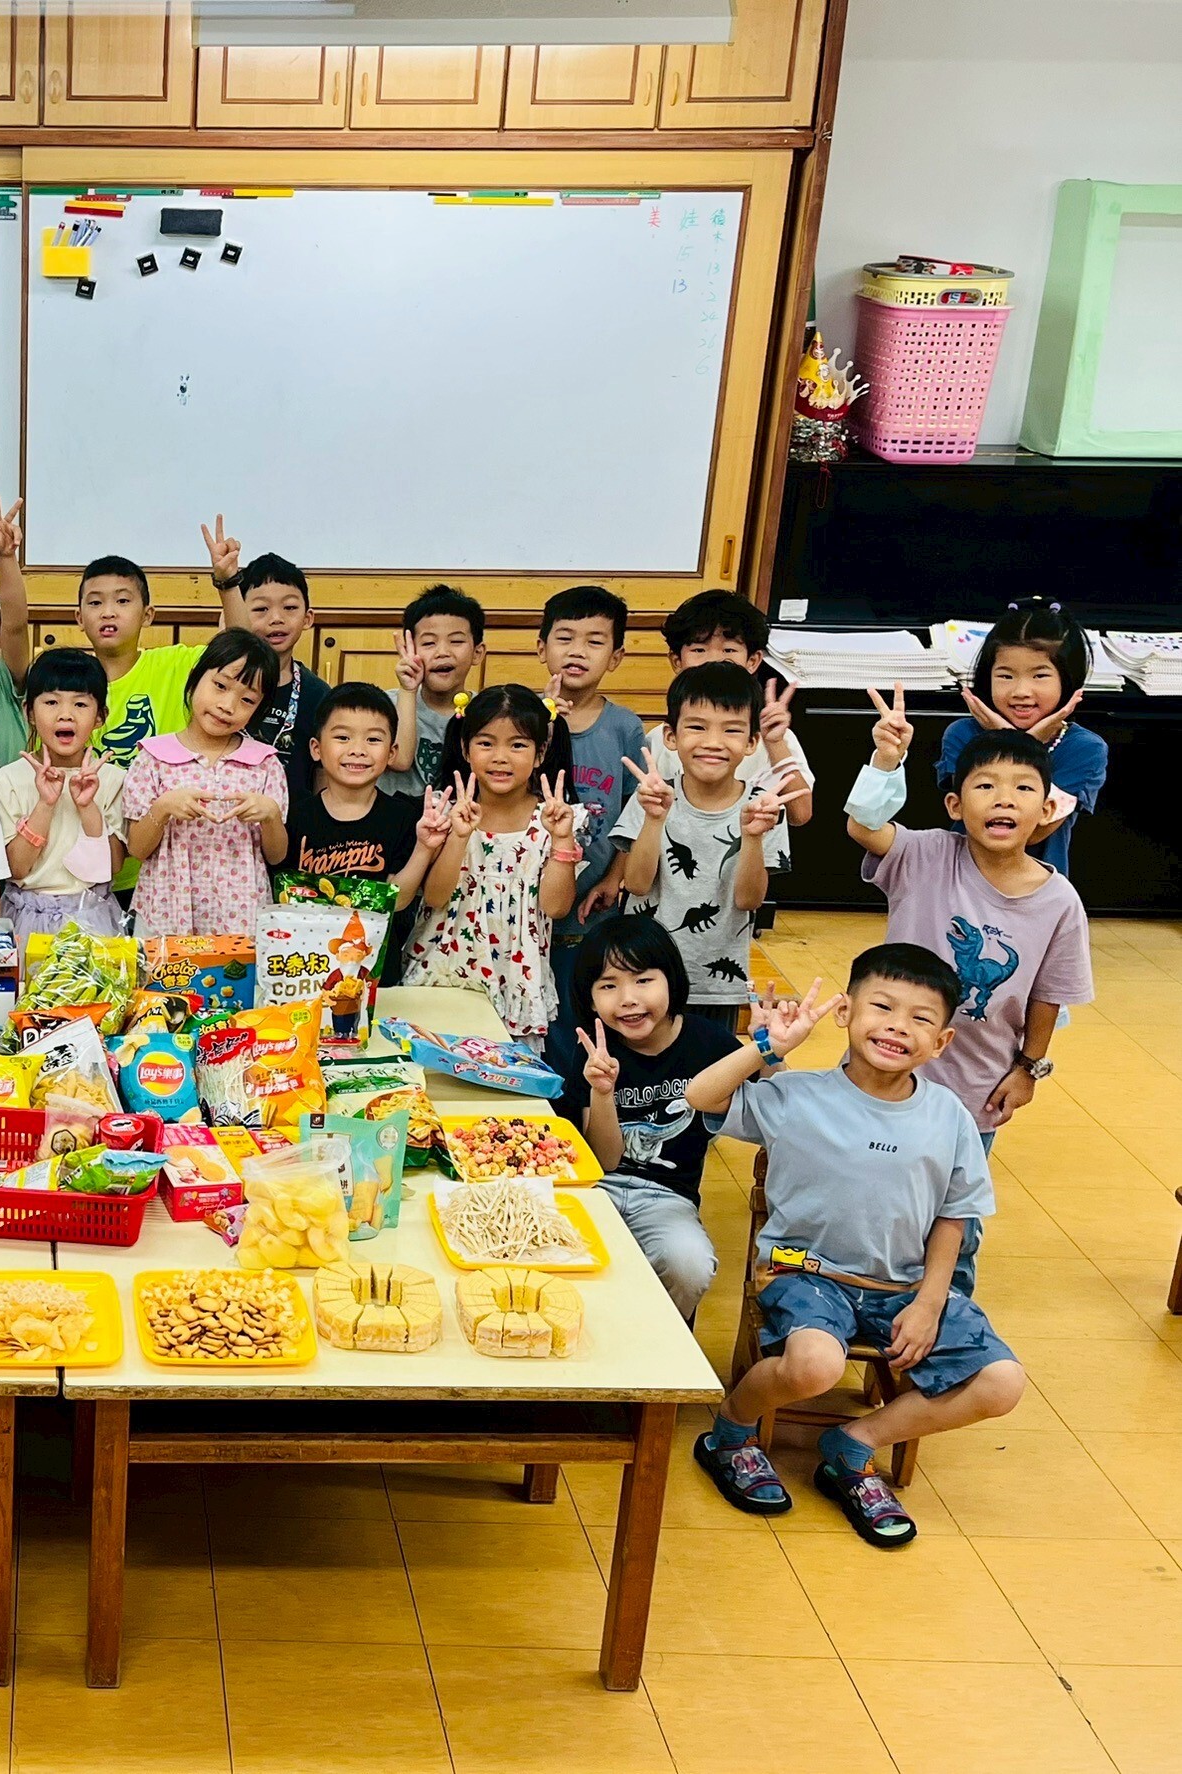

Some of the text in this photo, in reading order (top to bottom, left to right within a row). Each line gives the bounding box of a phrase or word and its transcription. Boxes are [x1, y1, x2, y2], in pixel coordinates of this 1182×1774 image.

[152, 961, 197, 980] Cheetos
[163, 975, 189, 988] 奇多
[272, 979, 326, 997] CORN
[140, 1067, 183, 1081] Lay's 樂事
[868, 1141, 898, 1153] BELLO
